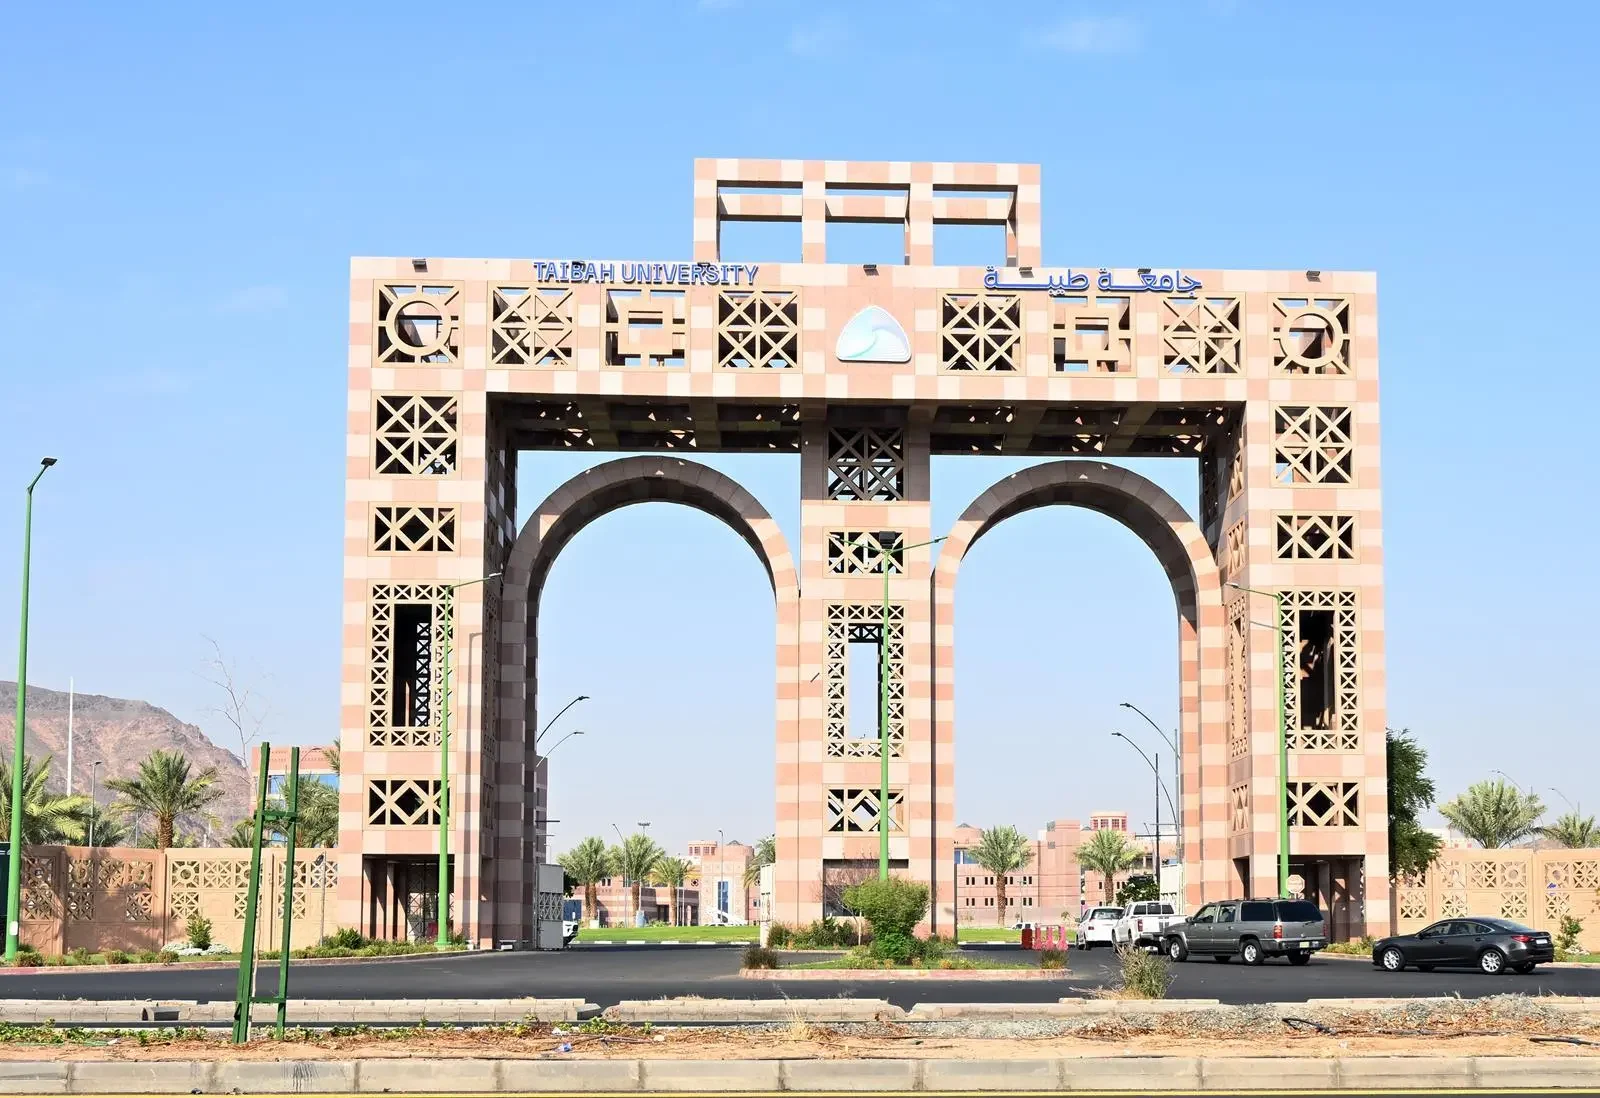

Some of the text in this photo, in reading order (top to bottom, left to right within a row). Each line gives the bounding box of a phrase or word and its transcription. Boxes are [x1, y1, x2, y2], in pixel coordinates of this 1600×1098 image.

[534, 261, 758, 285] TAIBAH UNIVERSITY
[984, 265, 1202, 297] جامعة طيبة
